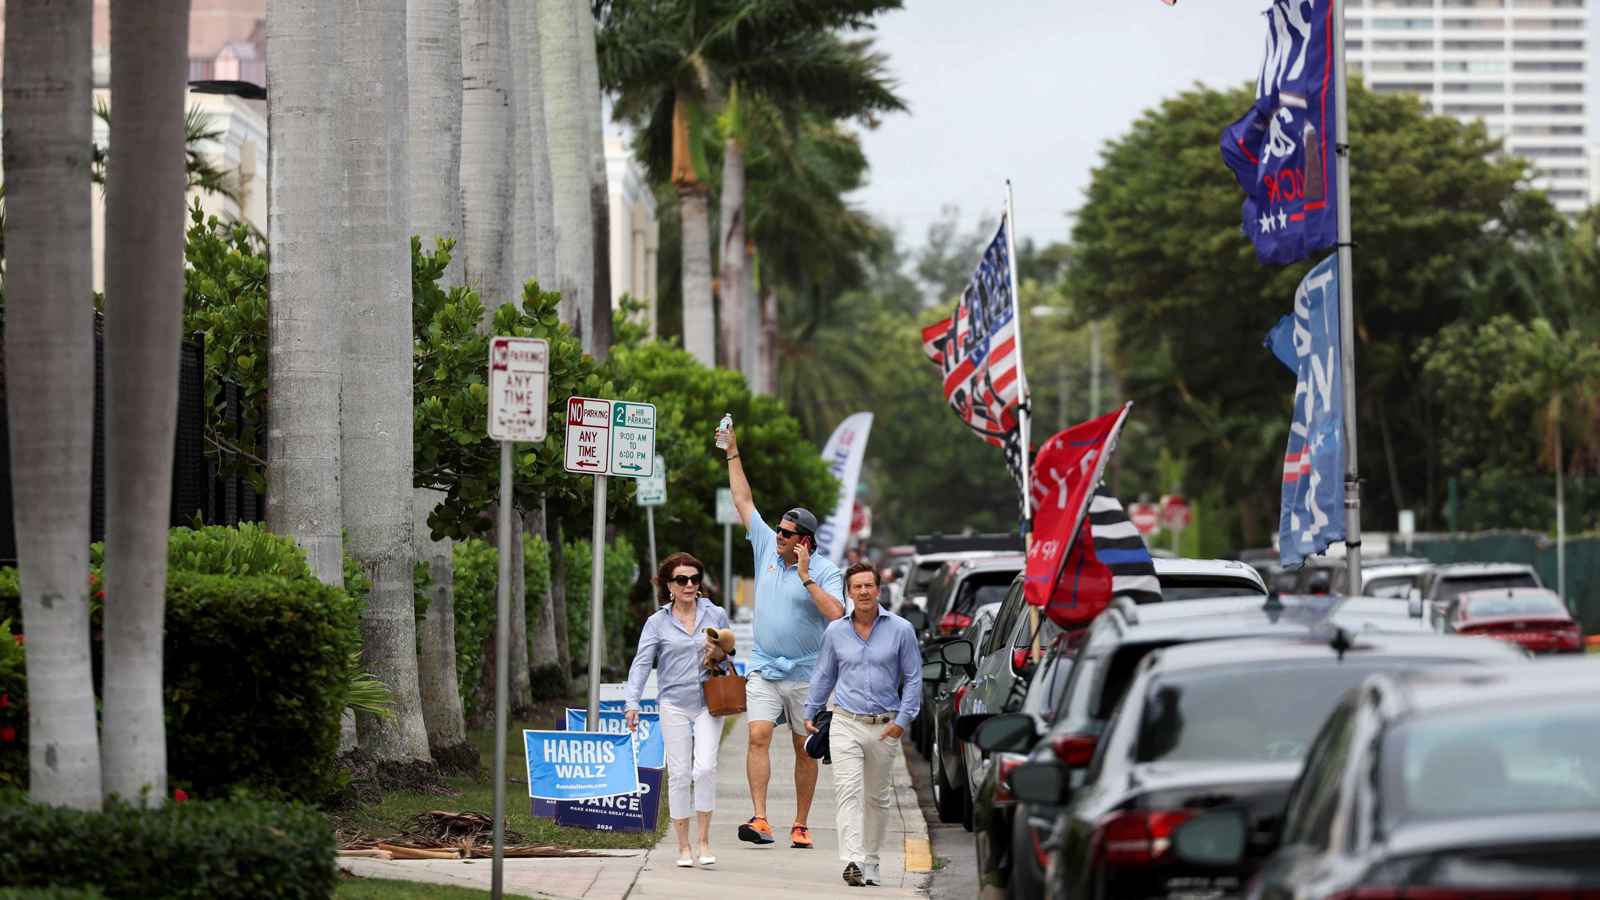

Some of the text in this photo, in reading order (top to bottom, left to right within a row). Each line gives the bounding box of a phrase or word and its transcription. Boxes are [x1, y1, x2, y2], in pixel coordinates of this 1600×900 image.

[507, 376, 531, 387] ANY
[504, 389, 532, 406] TIME
[570, 402, 608, 422] NO PARKING
[616, 406, 625, 423] 2
[627, 416, 651, 425] PARKING
[579, 431, 597, 442] ANY
[621, 432, 634, 440] 9:00
[629, 441, 636, 449] TO
[577, 445, 596, 457] TIME
[620, 450, 634, 458] 6:00
[544, 739, 615, 763] HARRIS
[555, 764, 606, 778] WALZ
